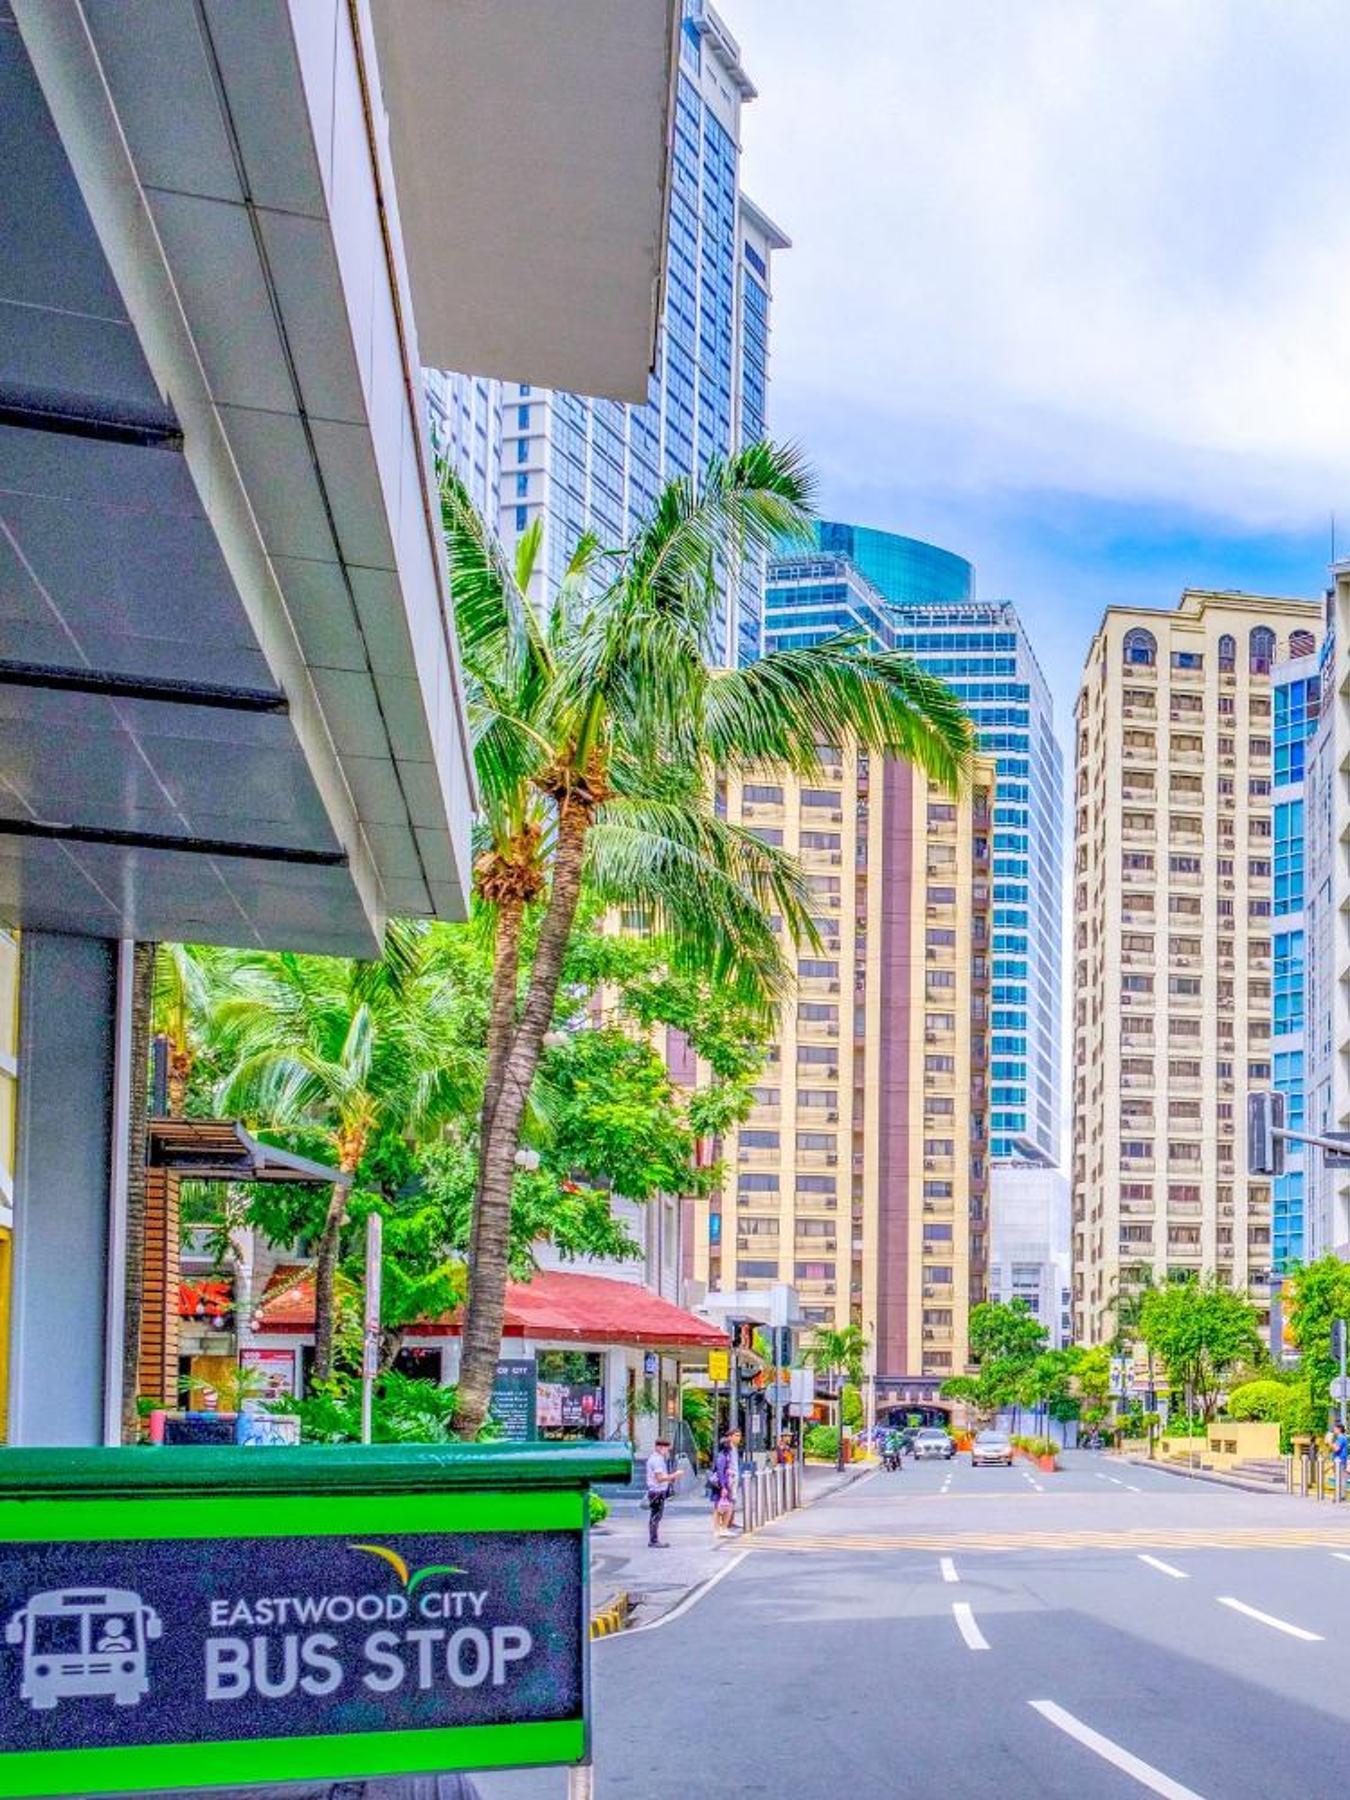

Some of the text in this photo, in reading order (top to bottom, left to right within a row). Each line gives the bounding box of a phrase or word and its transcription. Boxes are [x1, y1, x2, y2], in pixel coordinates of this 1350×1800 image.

[209, 1590, 489, 1626] EASTWOOD CITY
[204, 1625, 533, 1701] BUS STOP
